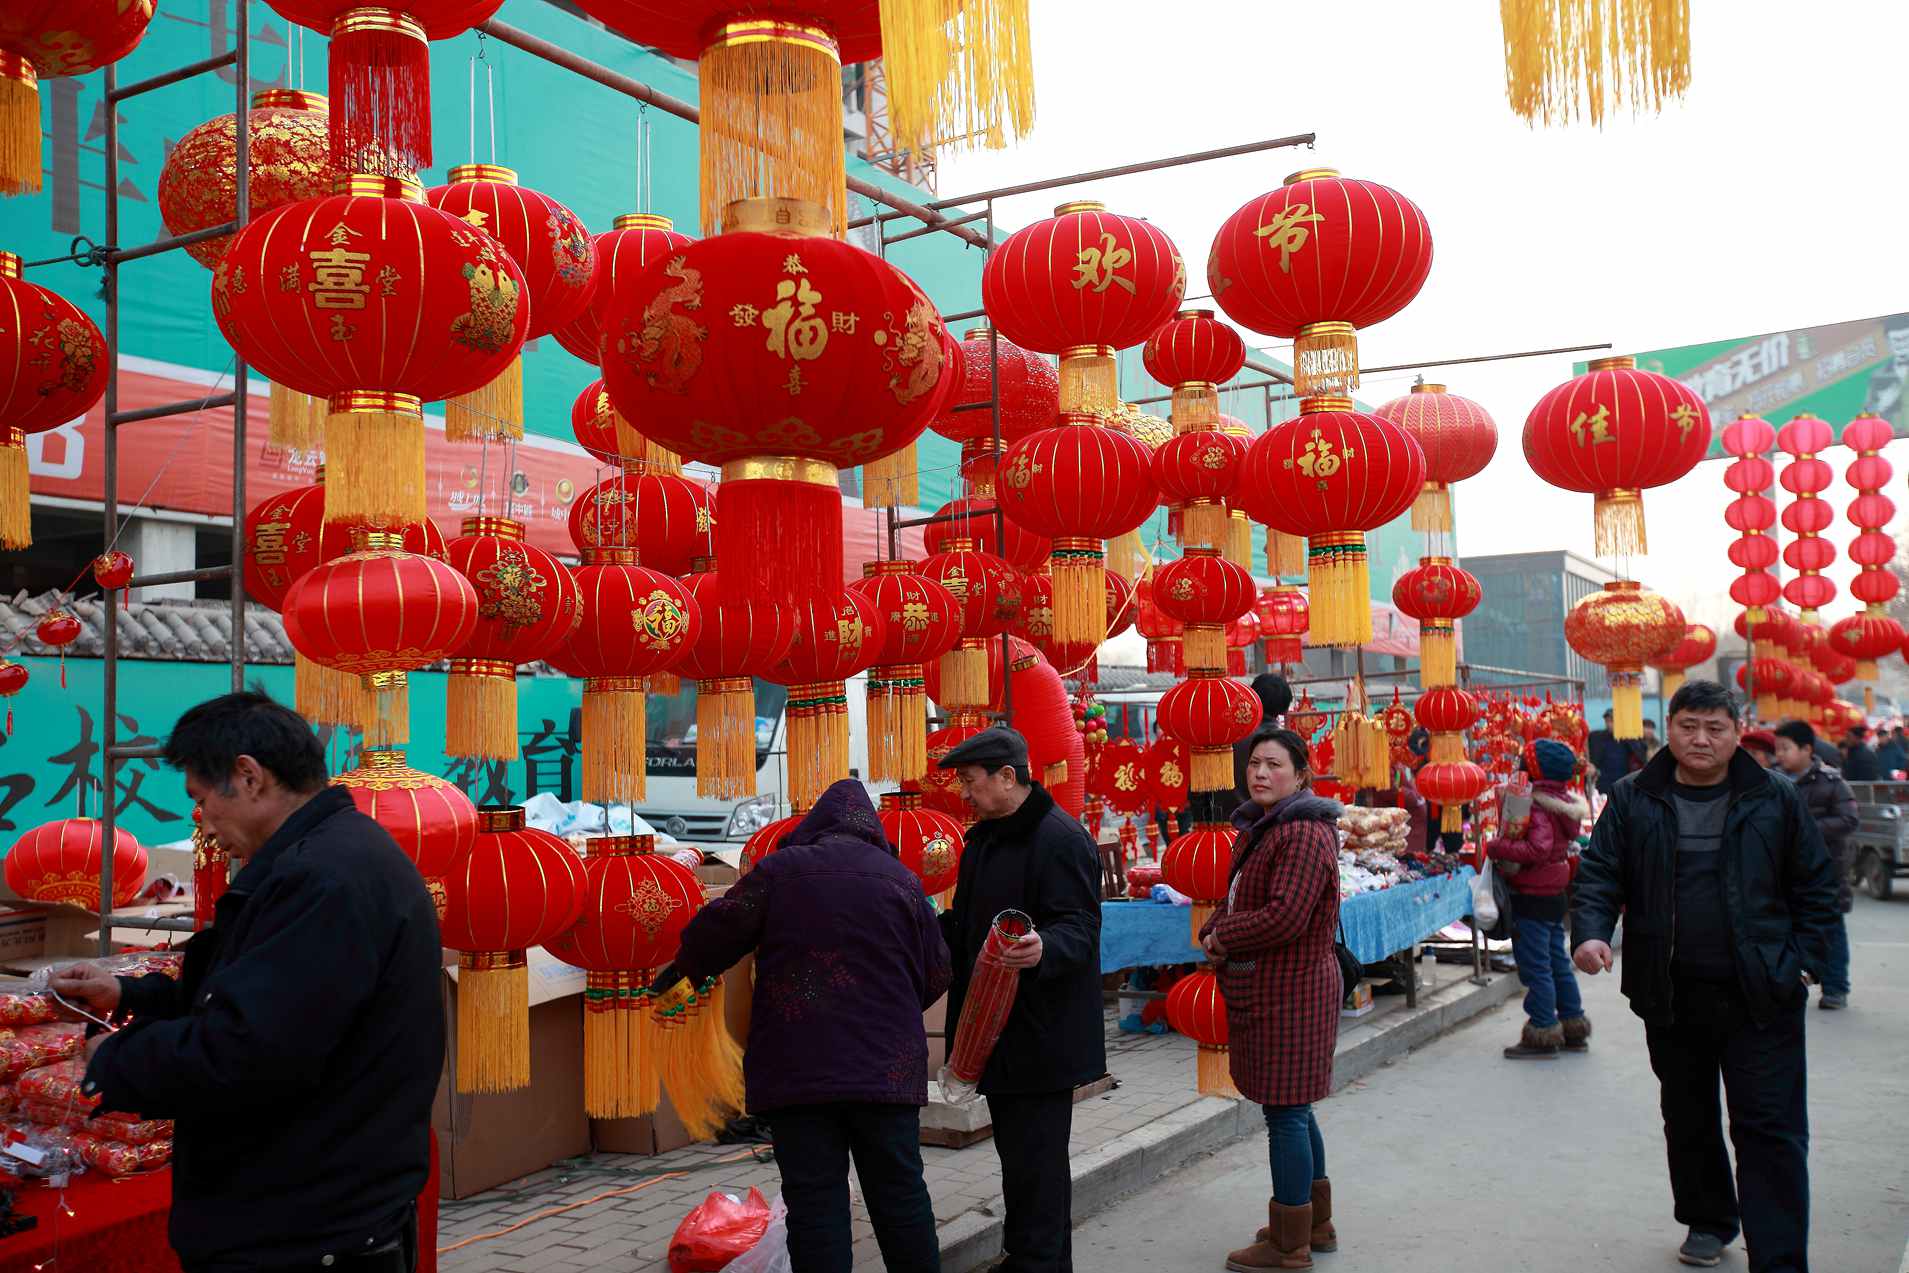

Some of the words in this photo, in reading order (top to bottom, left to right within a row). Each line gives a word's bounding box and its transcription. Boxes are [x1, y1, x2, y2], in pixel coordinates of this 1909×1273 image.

[324, 221, 364, 246] 金
[1253, 203, 1325, 274] 节
[308, 247, 371, 309] 喜
[782, 253, 808, 275] 恭
[1071, 232, 1136, 296] 欢
[761, 278, 829, 361] 福
[831, 311, 861, 334] 財
[1570, 403, 1617, 448] 佳
[1668, 402, 1700, 446] 节
[1297, 439, 1341, 478] 福
[838, 616, 862, 648] 財
[902, 602, 930, 632] 恭
